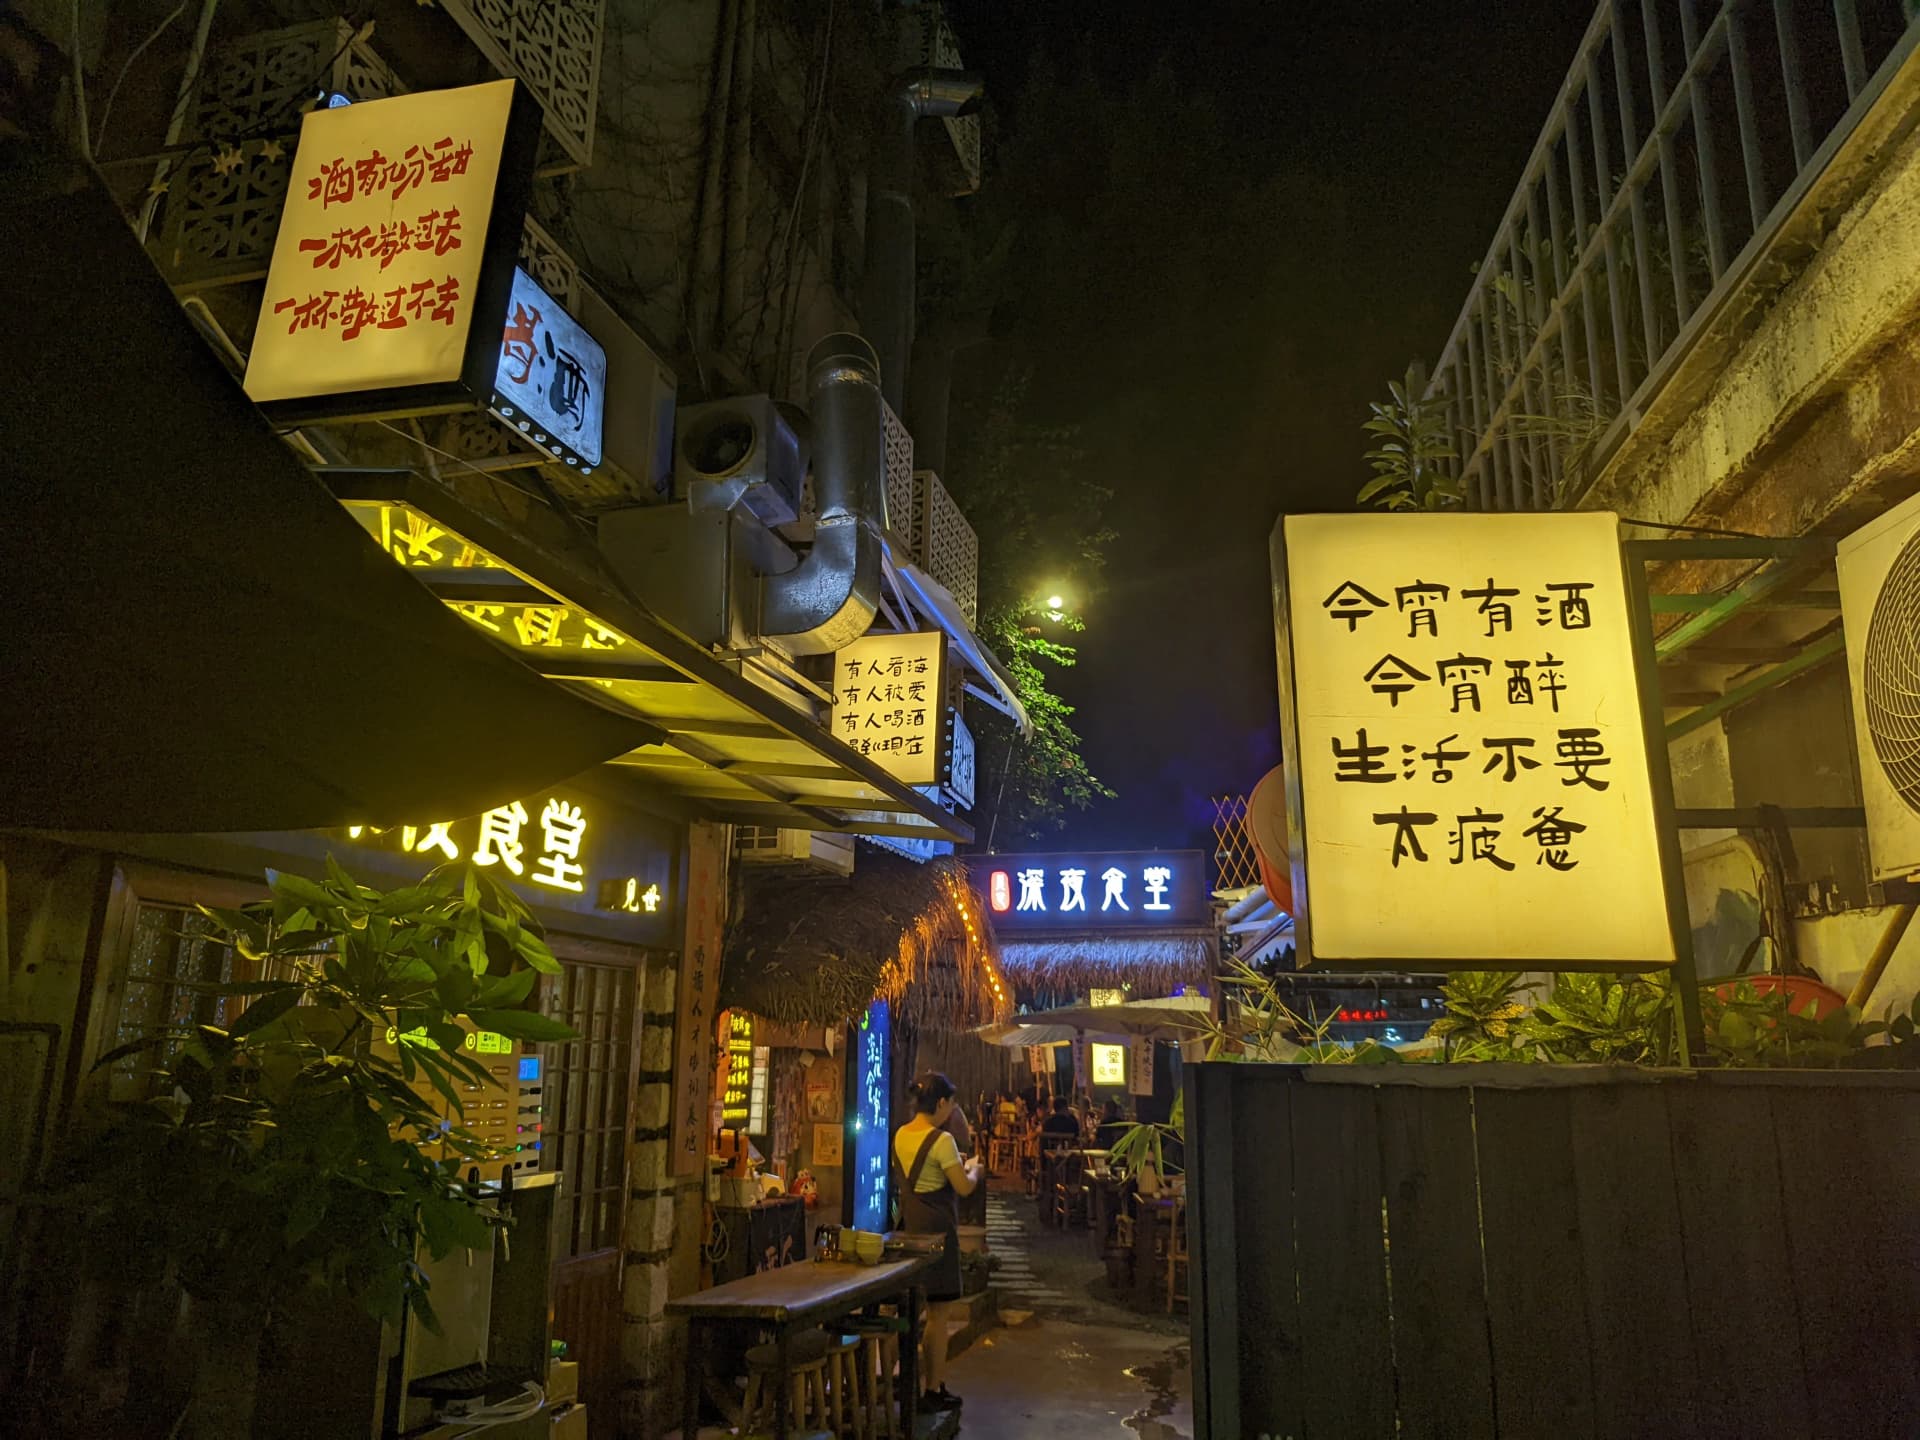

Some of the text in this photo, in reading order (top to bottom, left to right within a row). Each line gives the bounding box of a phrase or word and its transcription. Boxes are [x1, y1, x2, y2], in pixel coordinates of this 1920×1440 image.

[299, 205, 462, 269] 一杯敬过去
[274, 275, 460, 341] 一杯敬过不去
[1322, 577, 1595, 638] 今宵有酒
[844, 656, 929, 679] 有人看海
[1363, 652, 1568, 713] 今宵醉
[841, 708, 926, 732] 有人喝酒
[1331, 728, 1612, 791] 生活不要
[1373, 804, 1587, 872] 太疲惫
[1016, 866, 1171, 912] 深夜食堂
